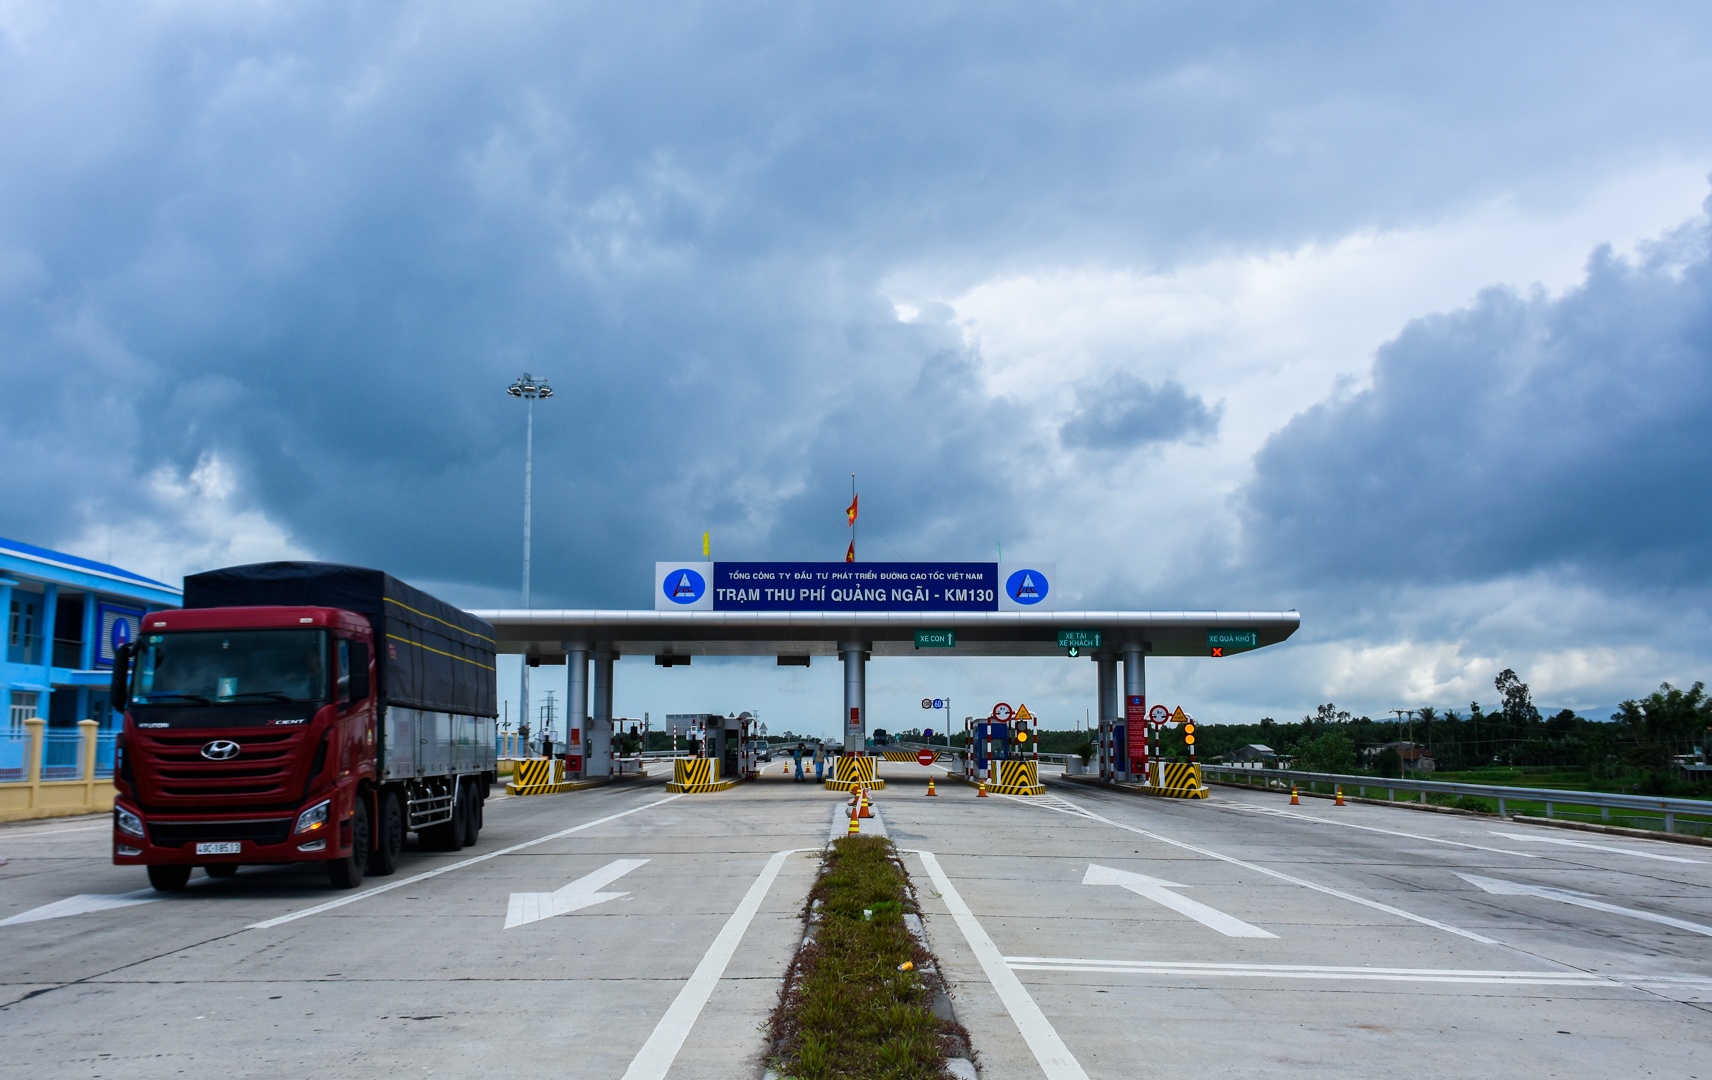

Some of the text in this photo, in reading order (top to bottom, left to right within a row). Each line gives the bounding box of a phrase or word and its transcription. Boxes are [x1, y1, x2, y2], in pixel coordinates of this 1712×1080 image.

[728, 569, 750, 579] TỔNG
[752, 571, 775, 579] CÔNG
[794, 570, 812, 579] ĐẦU
[832, 571, 853, 579] PHÁT
[855, 569, 877, 579] TRIỂN
[880, 571, 908, 580] ĐƯỜNG
[928, 570, 945, 580] TỐC
[946, 571, 964, 581] VIỆT
[716, 588, 760, 603] TRẠM
[765, 588, 795, 601] THU
[799, 585, 826, 601] PHÍ
[831, 583, 886, 602] QUẢNG
[891, 585, 929, 602] NGÃI
[944, 588, 994, 602] KM130
[934, 700, 941, 708] 60
